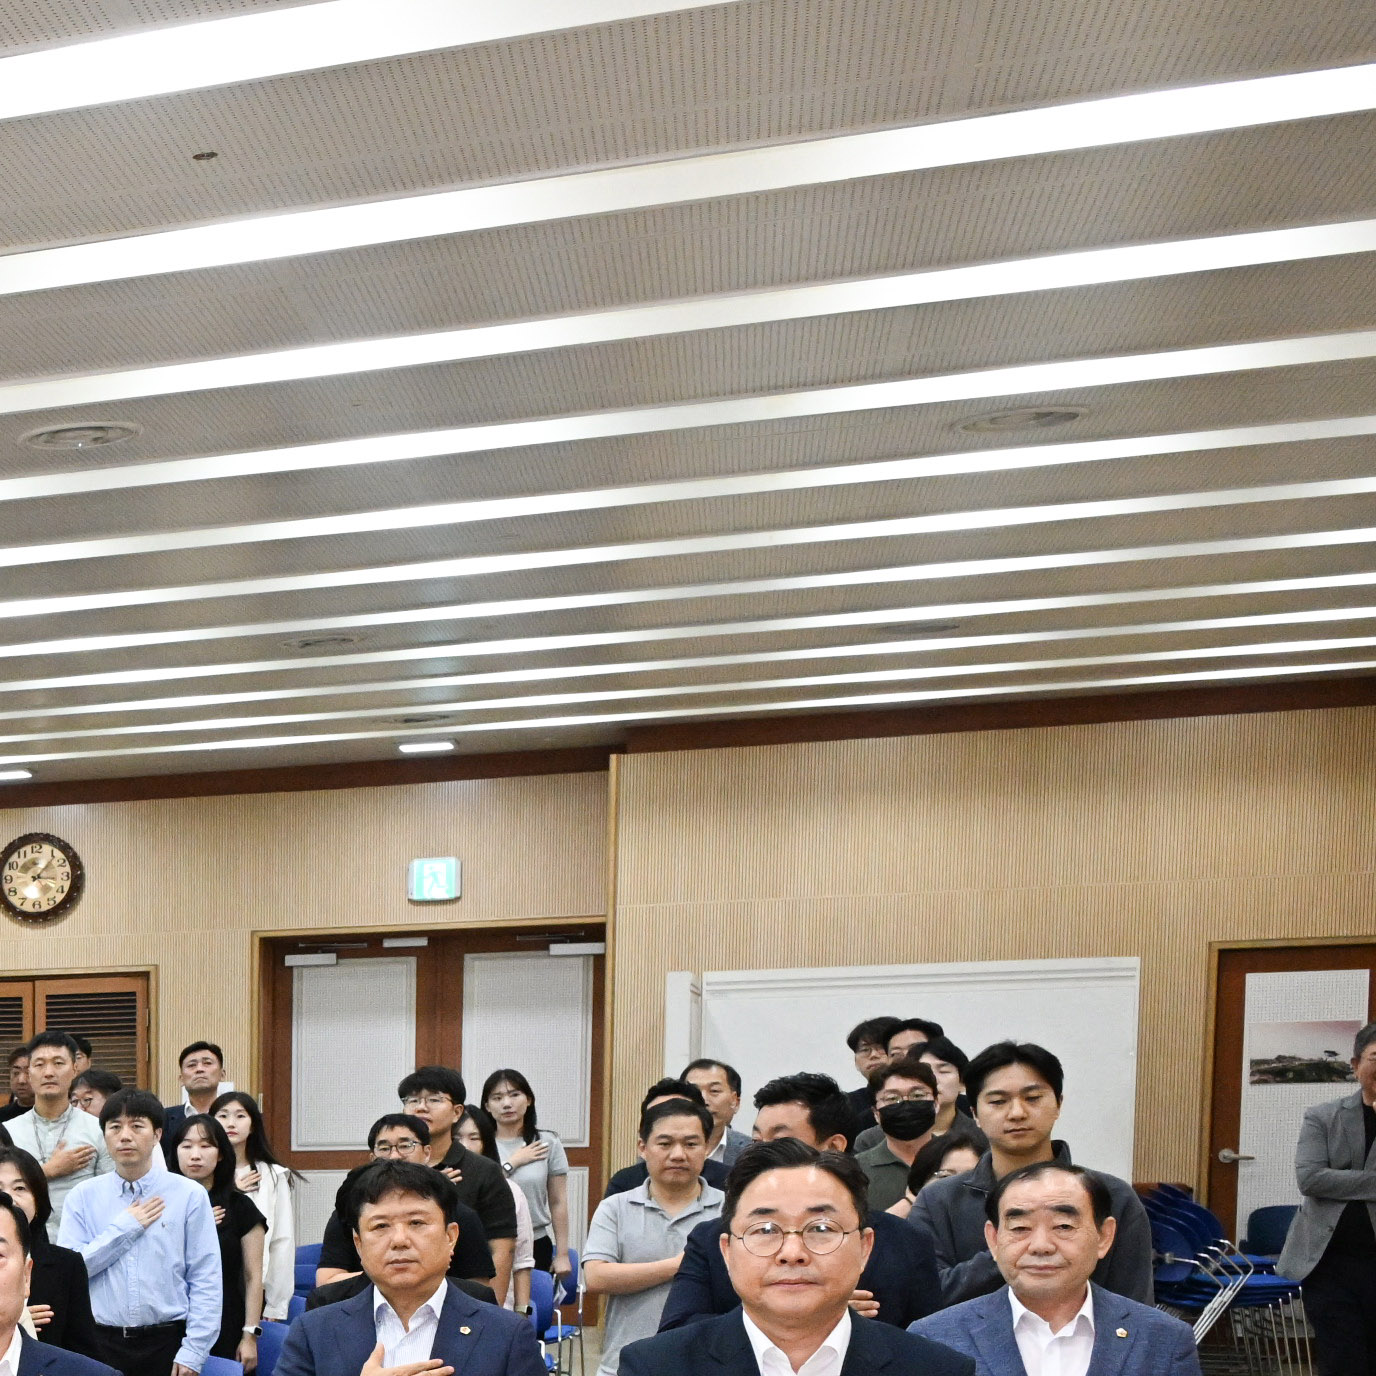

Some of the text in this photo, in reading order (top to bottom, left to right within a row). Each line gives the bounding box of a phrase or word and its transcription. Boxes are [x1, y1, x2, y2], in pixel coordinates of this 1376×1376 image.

[31, 844, 42, 854] 12
[18, 850, 26, 858] 11
[8, 861, 18, 870] 10
[57, 858, 66, 867] 2
[4, 875, 13, 884] 9
[61, 871, 70, 881] 3
[8, 887, 17, 896] 8
[56, 885, 64, 894] 4
[18, 898, 27, 906] 7
[32, 901, 41, 910] 6
[47, 896, 56, 906] 5
